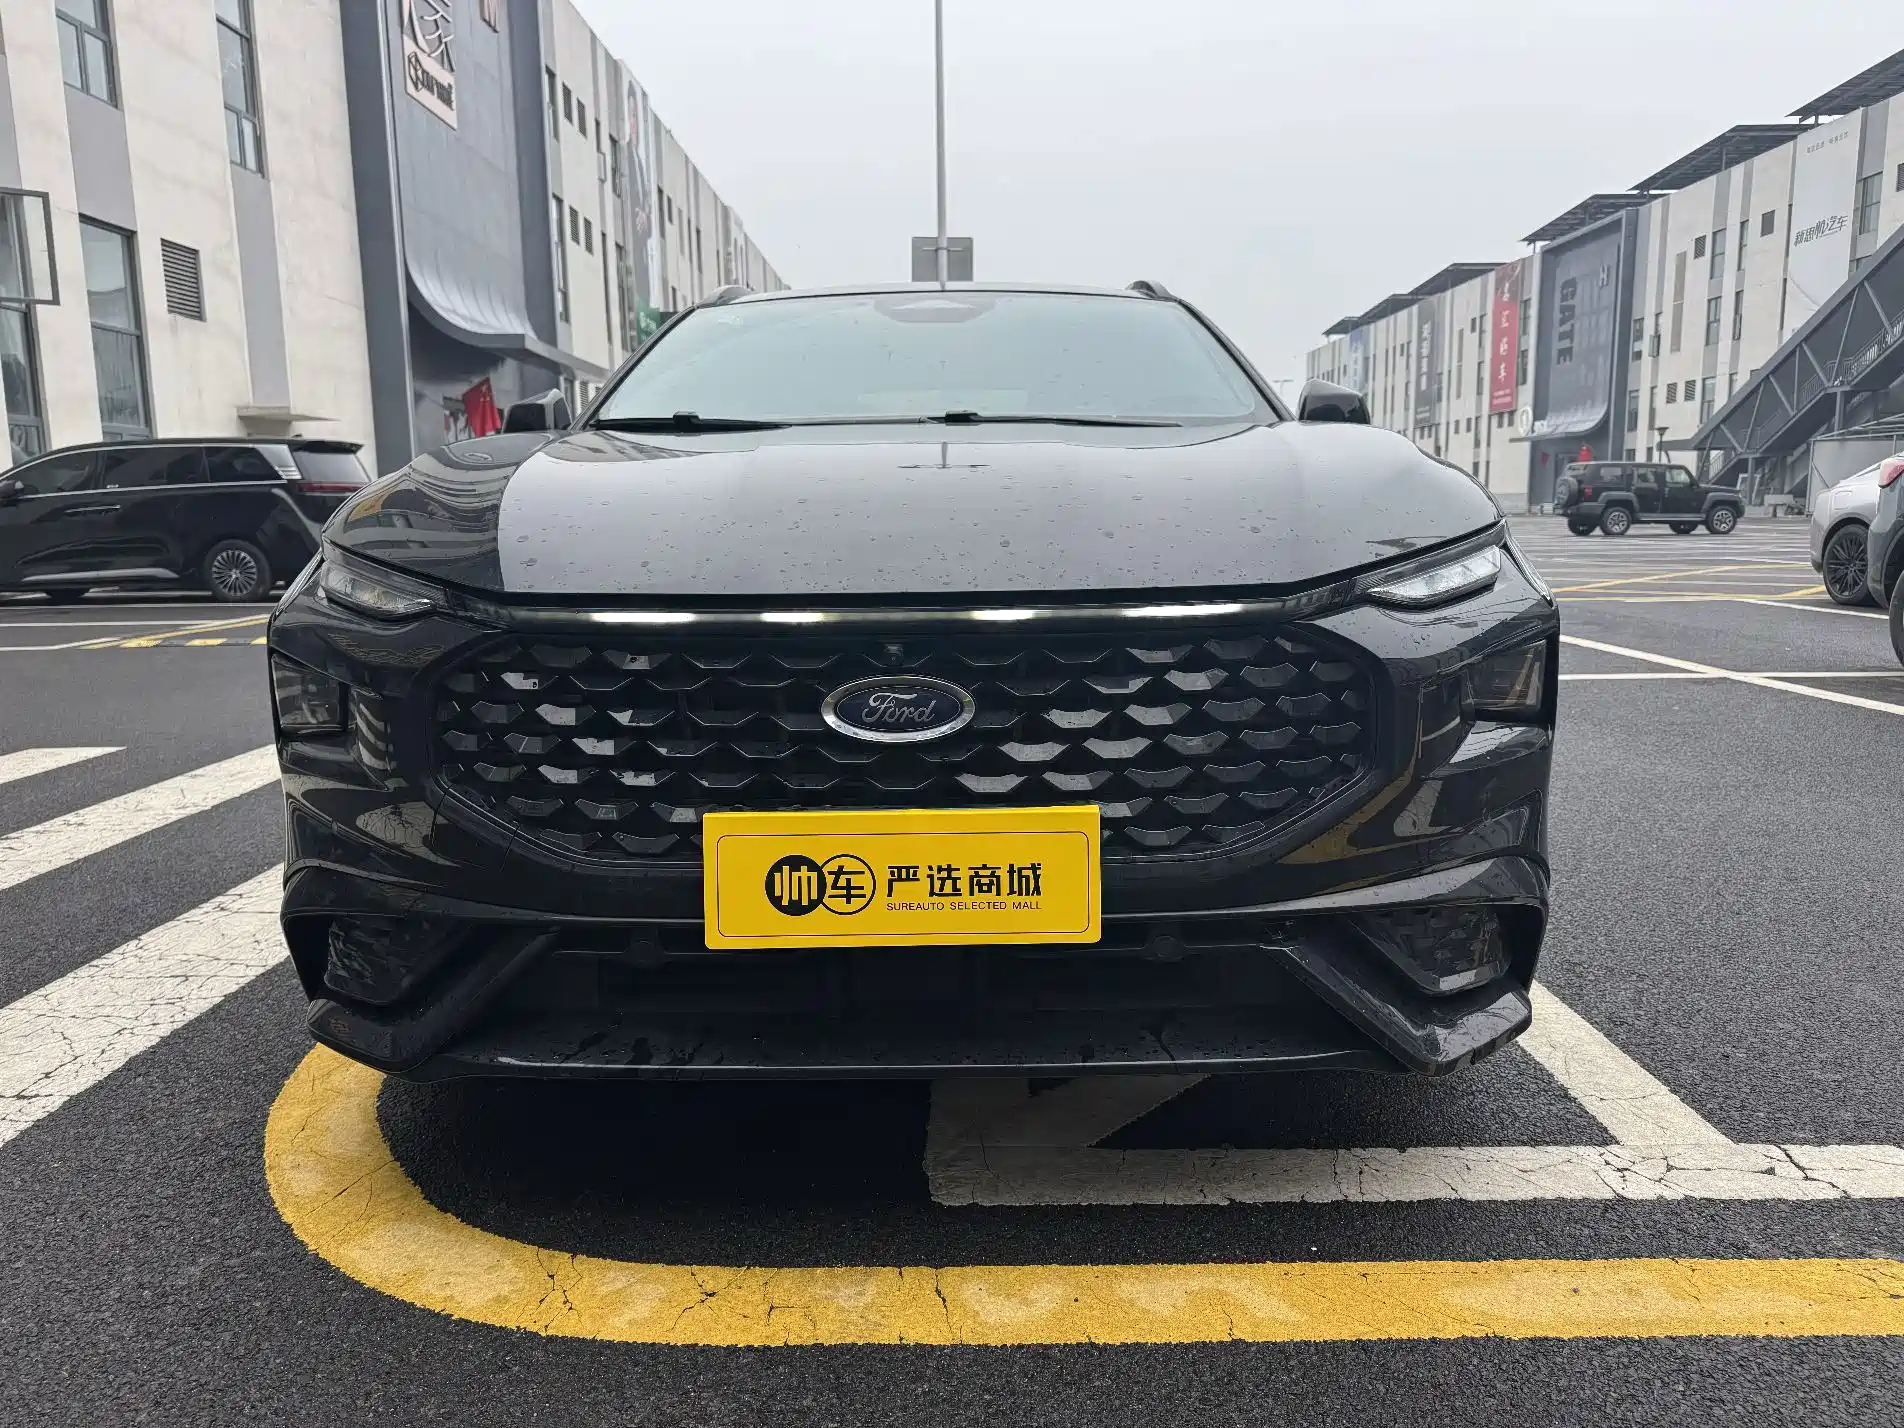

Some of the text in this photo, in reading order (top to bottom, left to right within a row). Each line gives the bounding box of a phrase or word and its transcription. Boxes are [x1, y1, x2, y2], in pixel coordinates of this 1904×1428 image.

[1556, 277, 1578, 365] GATE
[861, 692, 937, 723] Ford
[886, 863, 1042, 898] 严选商城
[886, 900, 1043, 912] SUREAUTO SELECTED MALL
